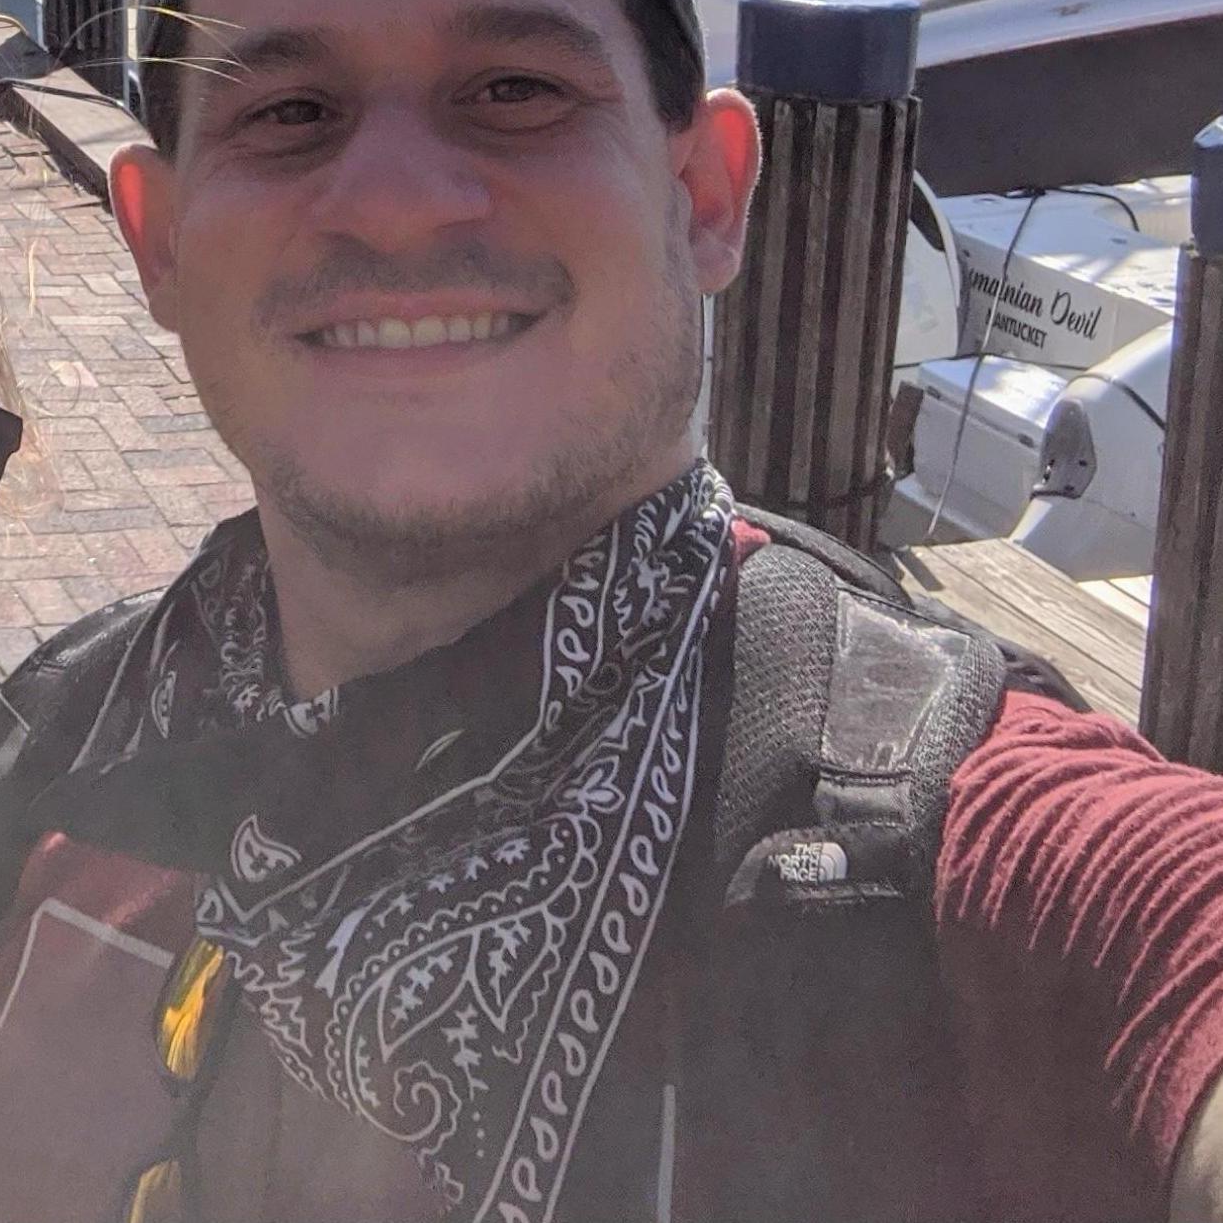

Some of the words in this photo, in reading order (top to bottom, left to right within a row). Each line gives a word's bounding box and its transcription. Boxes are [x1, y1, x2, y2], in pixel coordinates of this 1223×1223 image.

[1051, 289, 1103, 340] Devil
[793, 842, 822, 856] THE
[768, 853, 819, 869] NORTH
[780, 867, 818, 882] FACE
